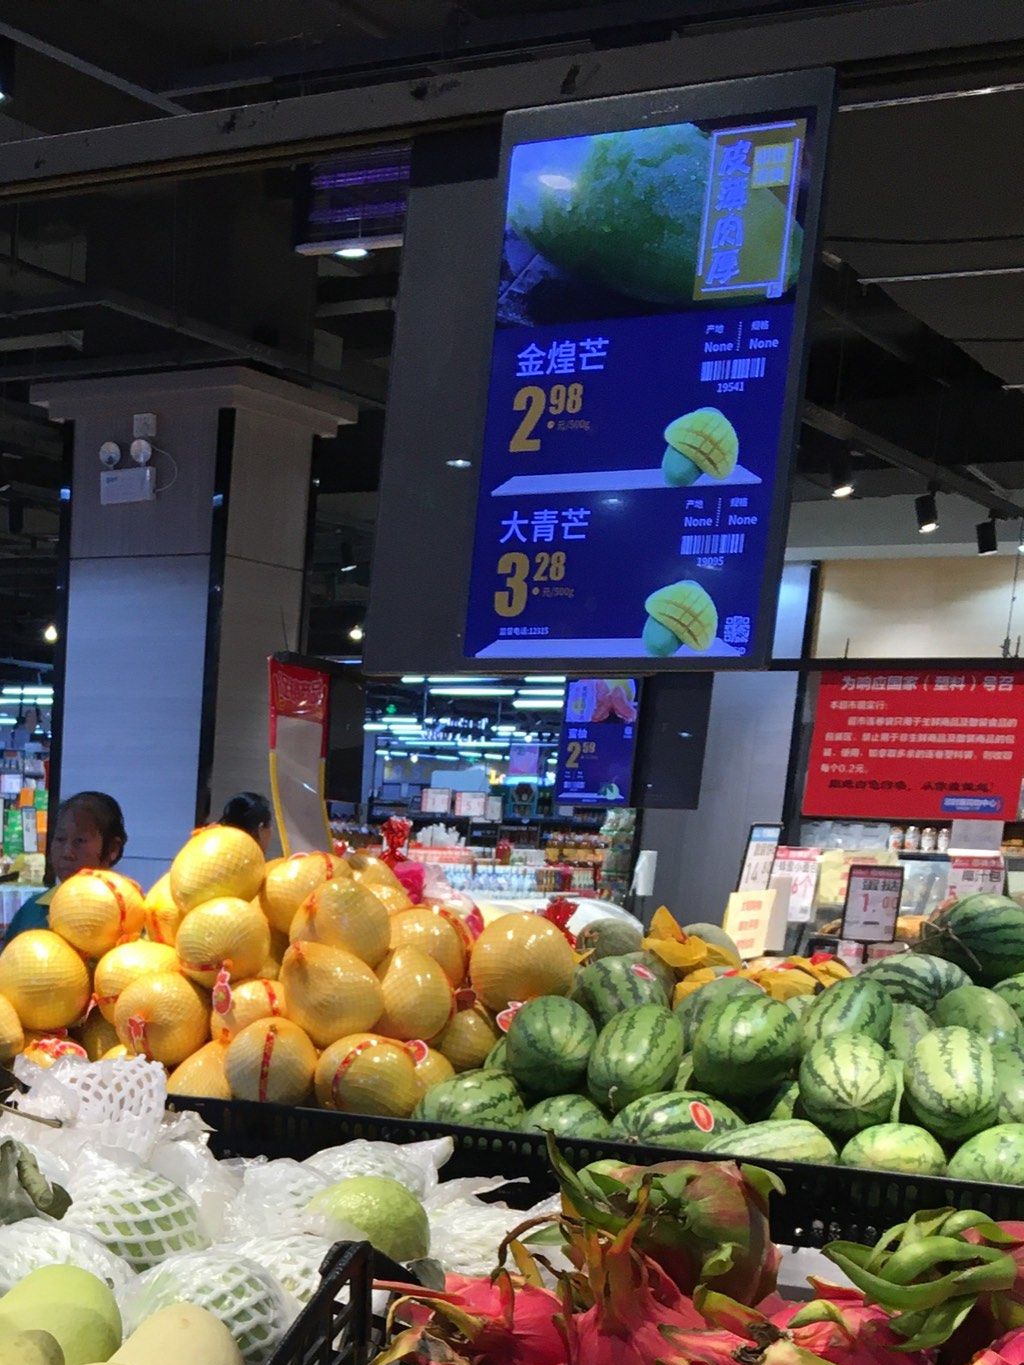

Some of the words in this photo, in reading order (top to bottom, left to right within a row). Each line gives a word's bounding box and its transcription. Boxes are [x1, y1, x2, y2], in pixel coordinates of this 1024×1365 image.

[704, 342, 733, 353] None
[749, 338, 779, 349] None
[516, 337, 609, 377] 金煌芒
[684, 516, 713, 527] None
[728, 514, 757, 525] None
[499, 508, 591, 543] 大青芒
